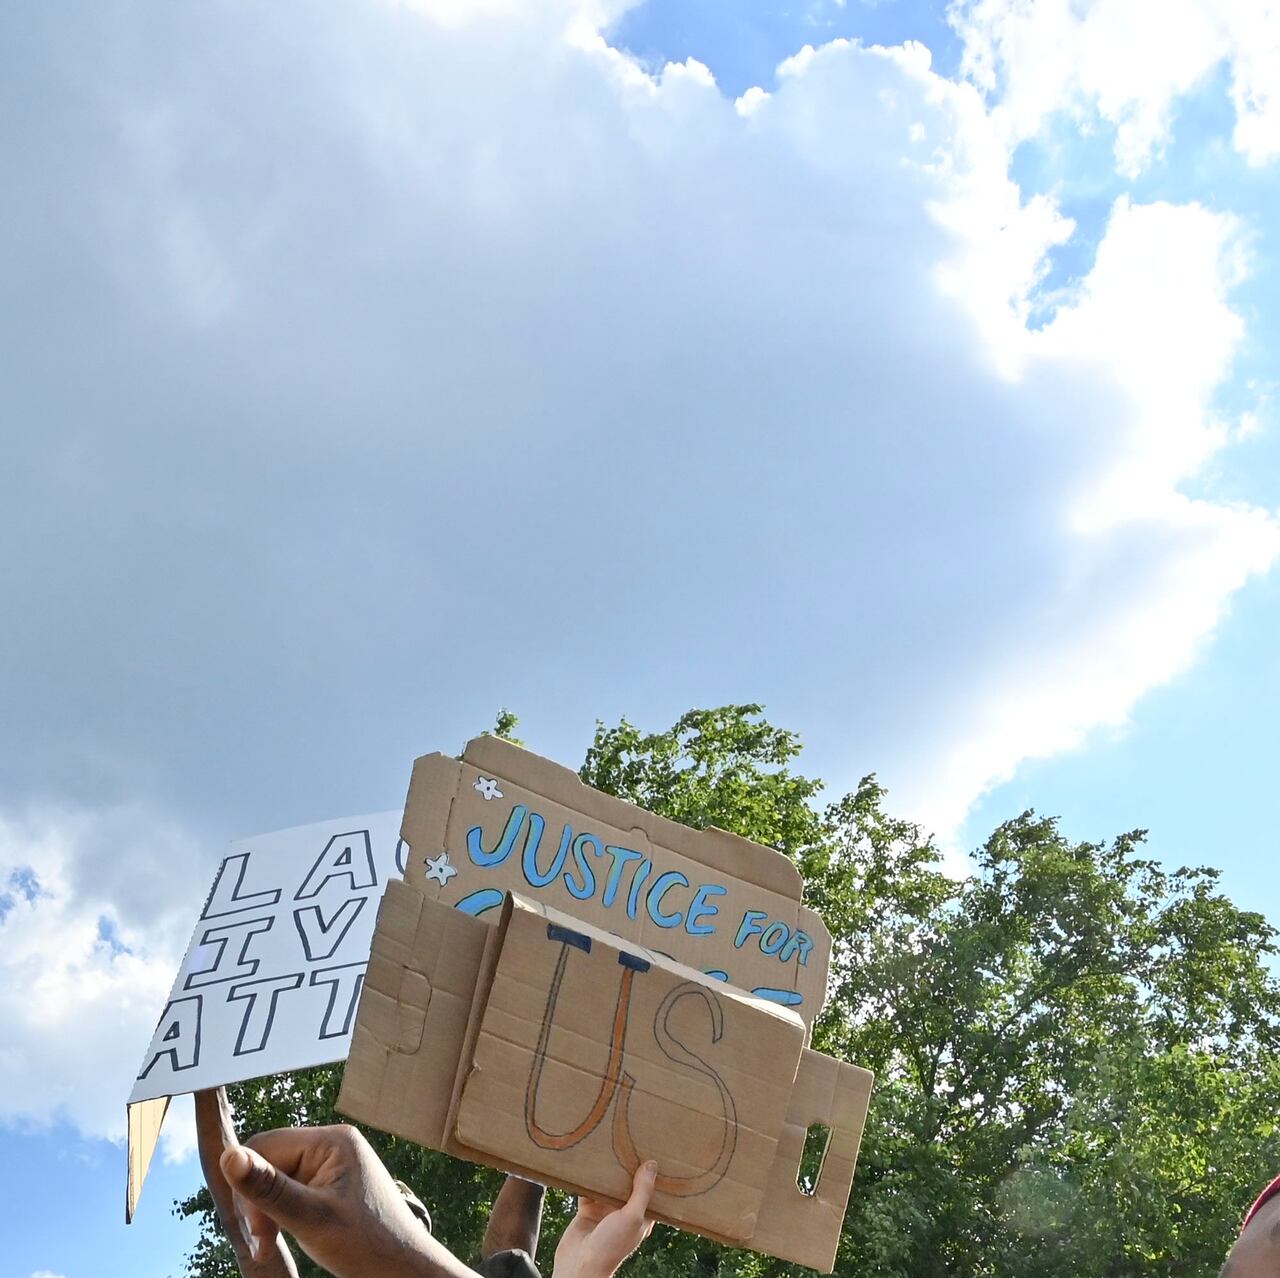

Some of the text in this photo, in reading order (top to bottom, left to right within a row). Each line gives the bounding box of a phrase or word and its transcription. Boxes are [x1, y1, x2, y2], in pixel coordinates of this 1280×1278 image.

[200, 829, 408, 921] LA
[466, 804, 814, 967] JUSTICE FOR
[136, 960, 370, 1081] ATT
[523, 923, 737, 1197] US
